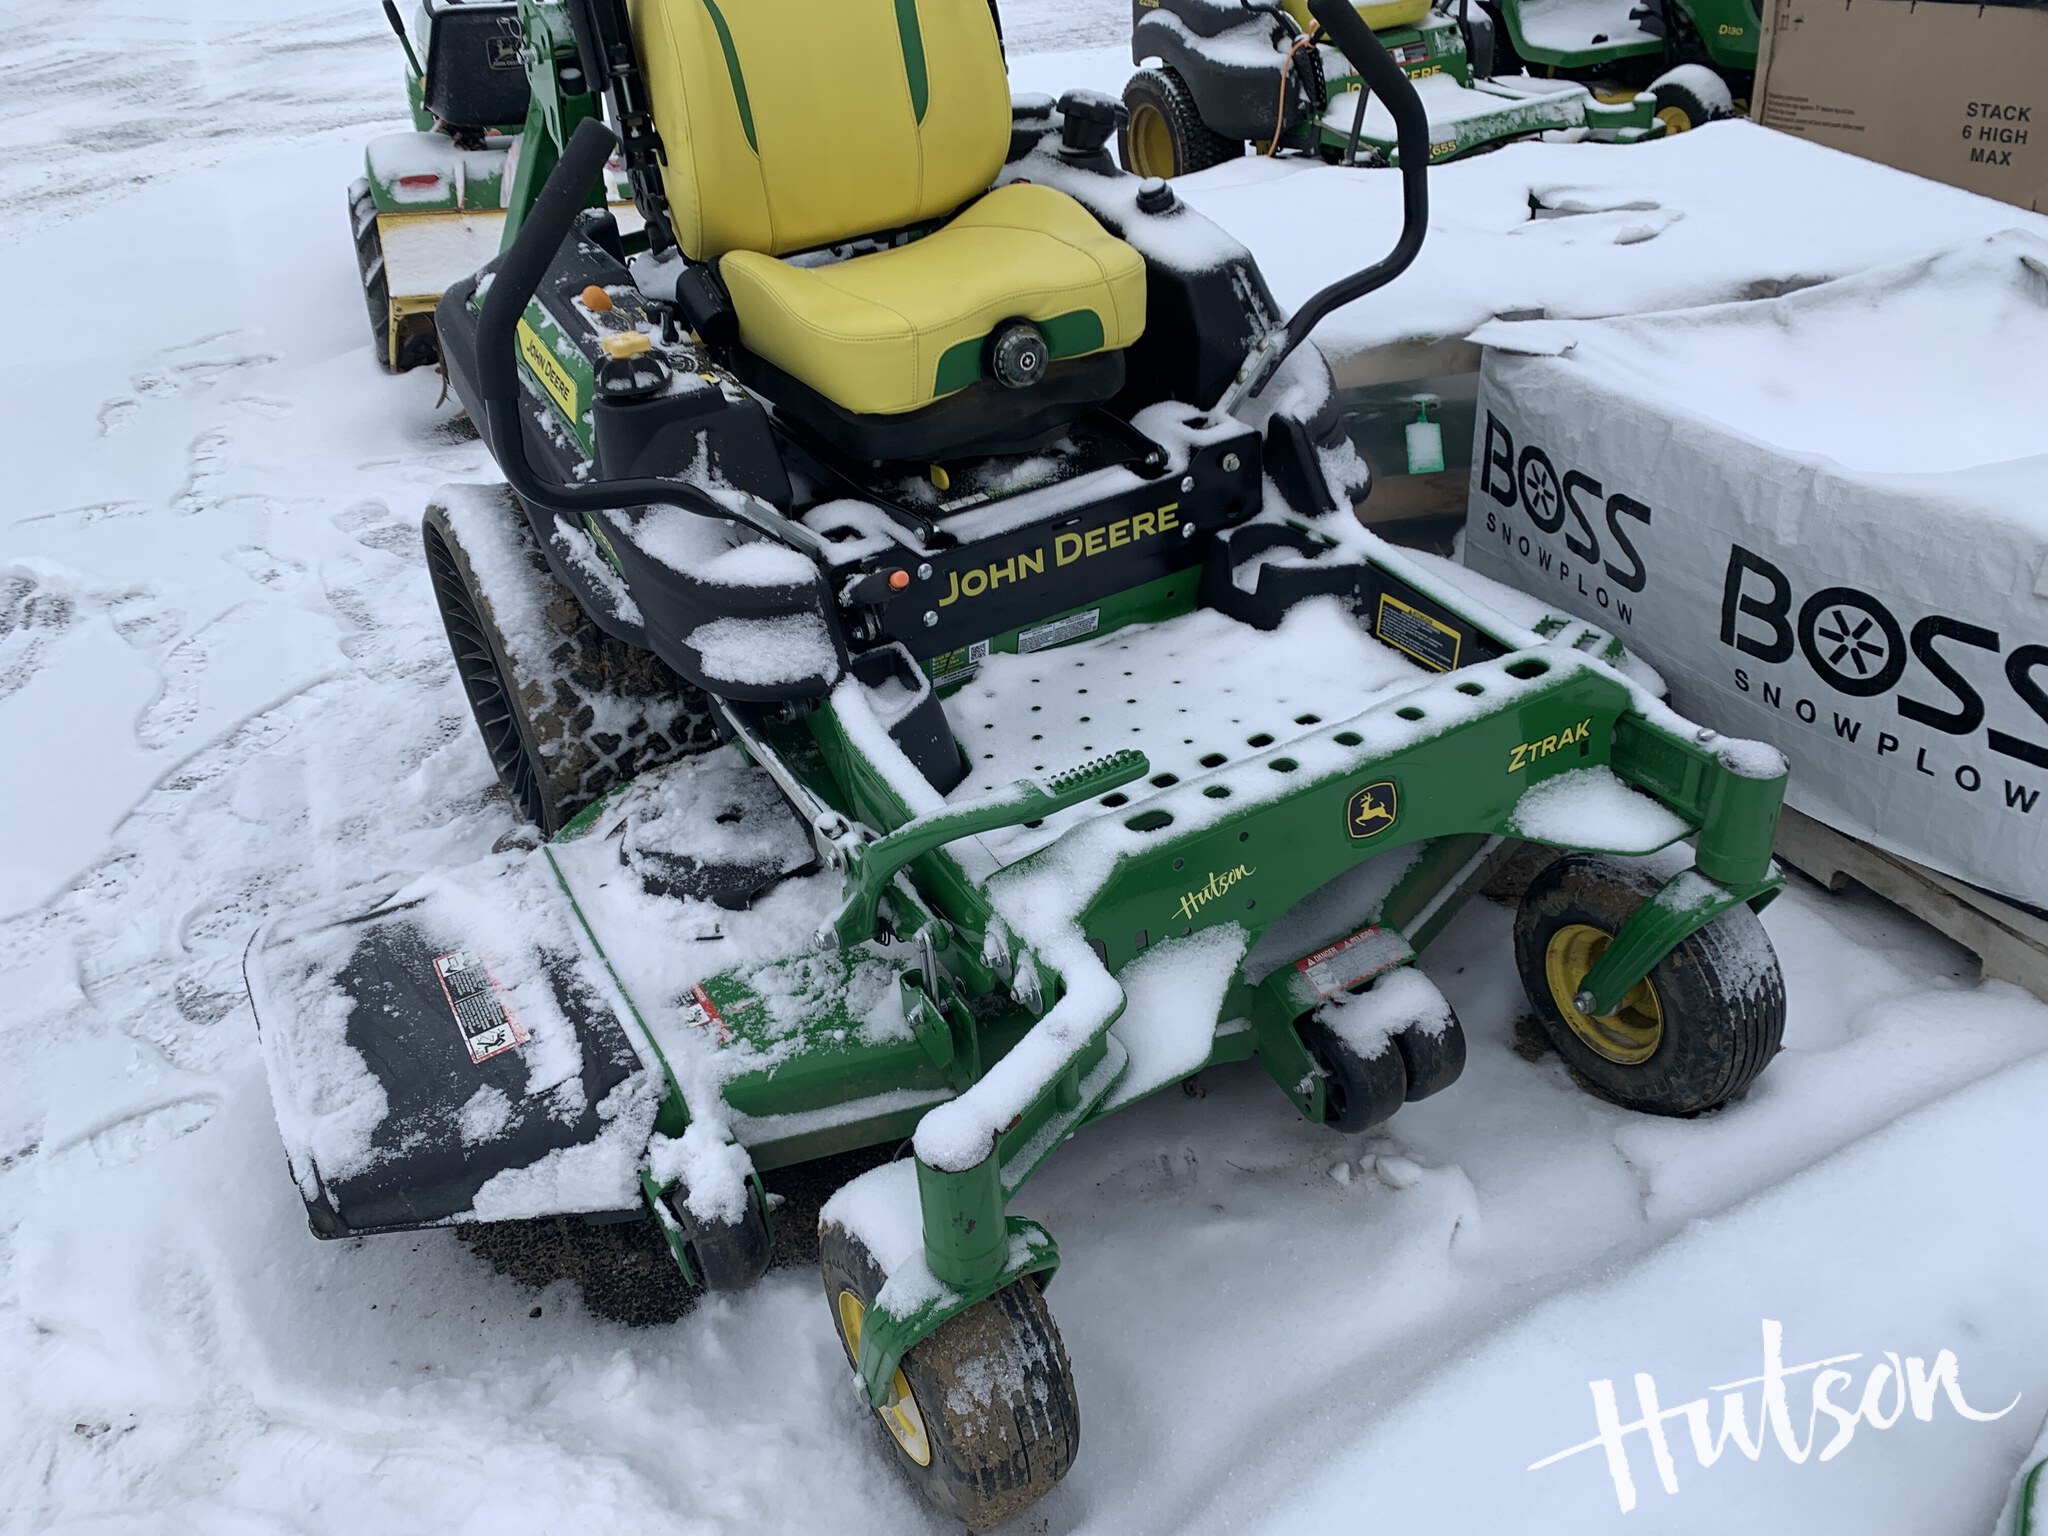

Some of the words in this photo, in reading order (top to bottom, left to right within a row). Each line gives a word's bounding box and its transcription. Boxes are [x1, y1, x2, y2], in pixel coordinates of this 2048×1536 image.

[1962, 125, 1973, 139] 6
[1979, 126, 2028, 144] HIGH
[1966, 102, 2032, 122] STACK
[1970, 147, 2012, 166] MAX
[526, 339, 546, 371] JOHN
[544, 361, 570, 401] DEERE
[1481, 409, 1651, 593] BOSS
[938, 548, 1045, 607] JOHN
[1054, 502, 1179, 567] DEERE
[1486, 512, 1632, 625] SNOWPLOW
[1507, 717, 1592, 773] ZTRAK
[1734, 668, 2040, 813] SNOWPLOW
[1171, 864, 1256, 920] Hutson
[1313, 946, 1338, 962] DANGER
[1349, 928, 1375, 944] PELIGRO
